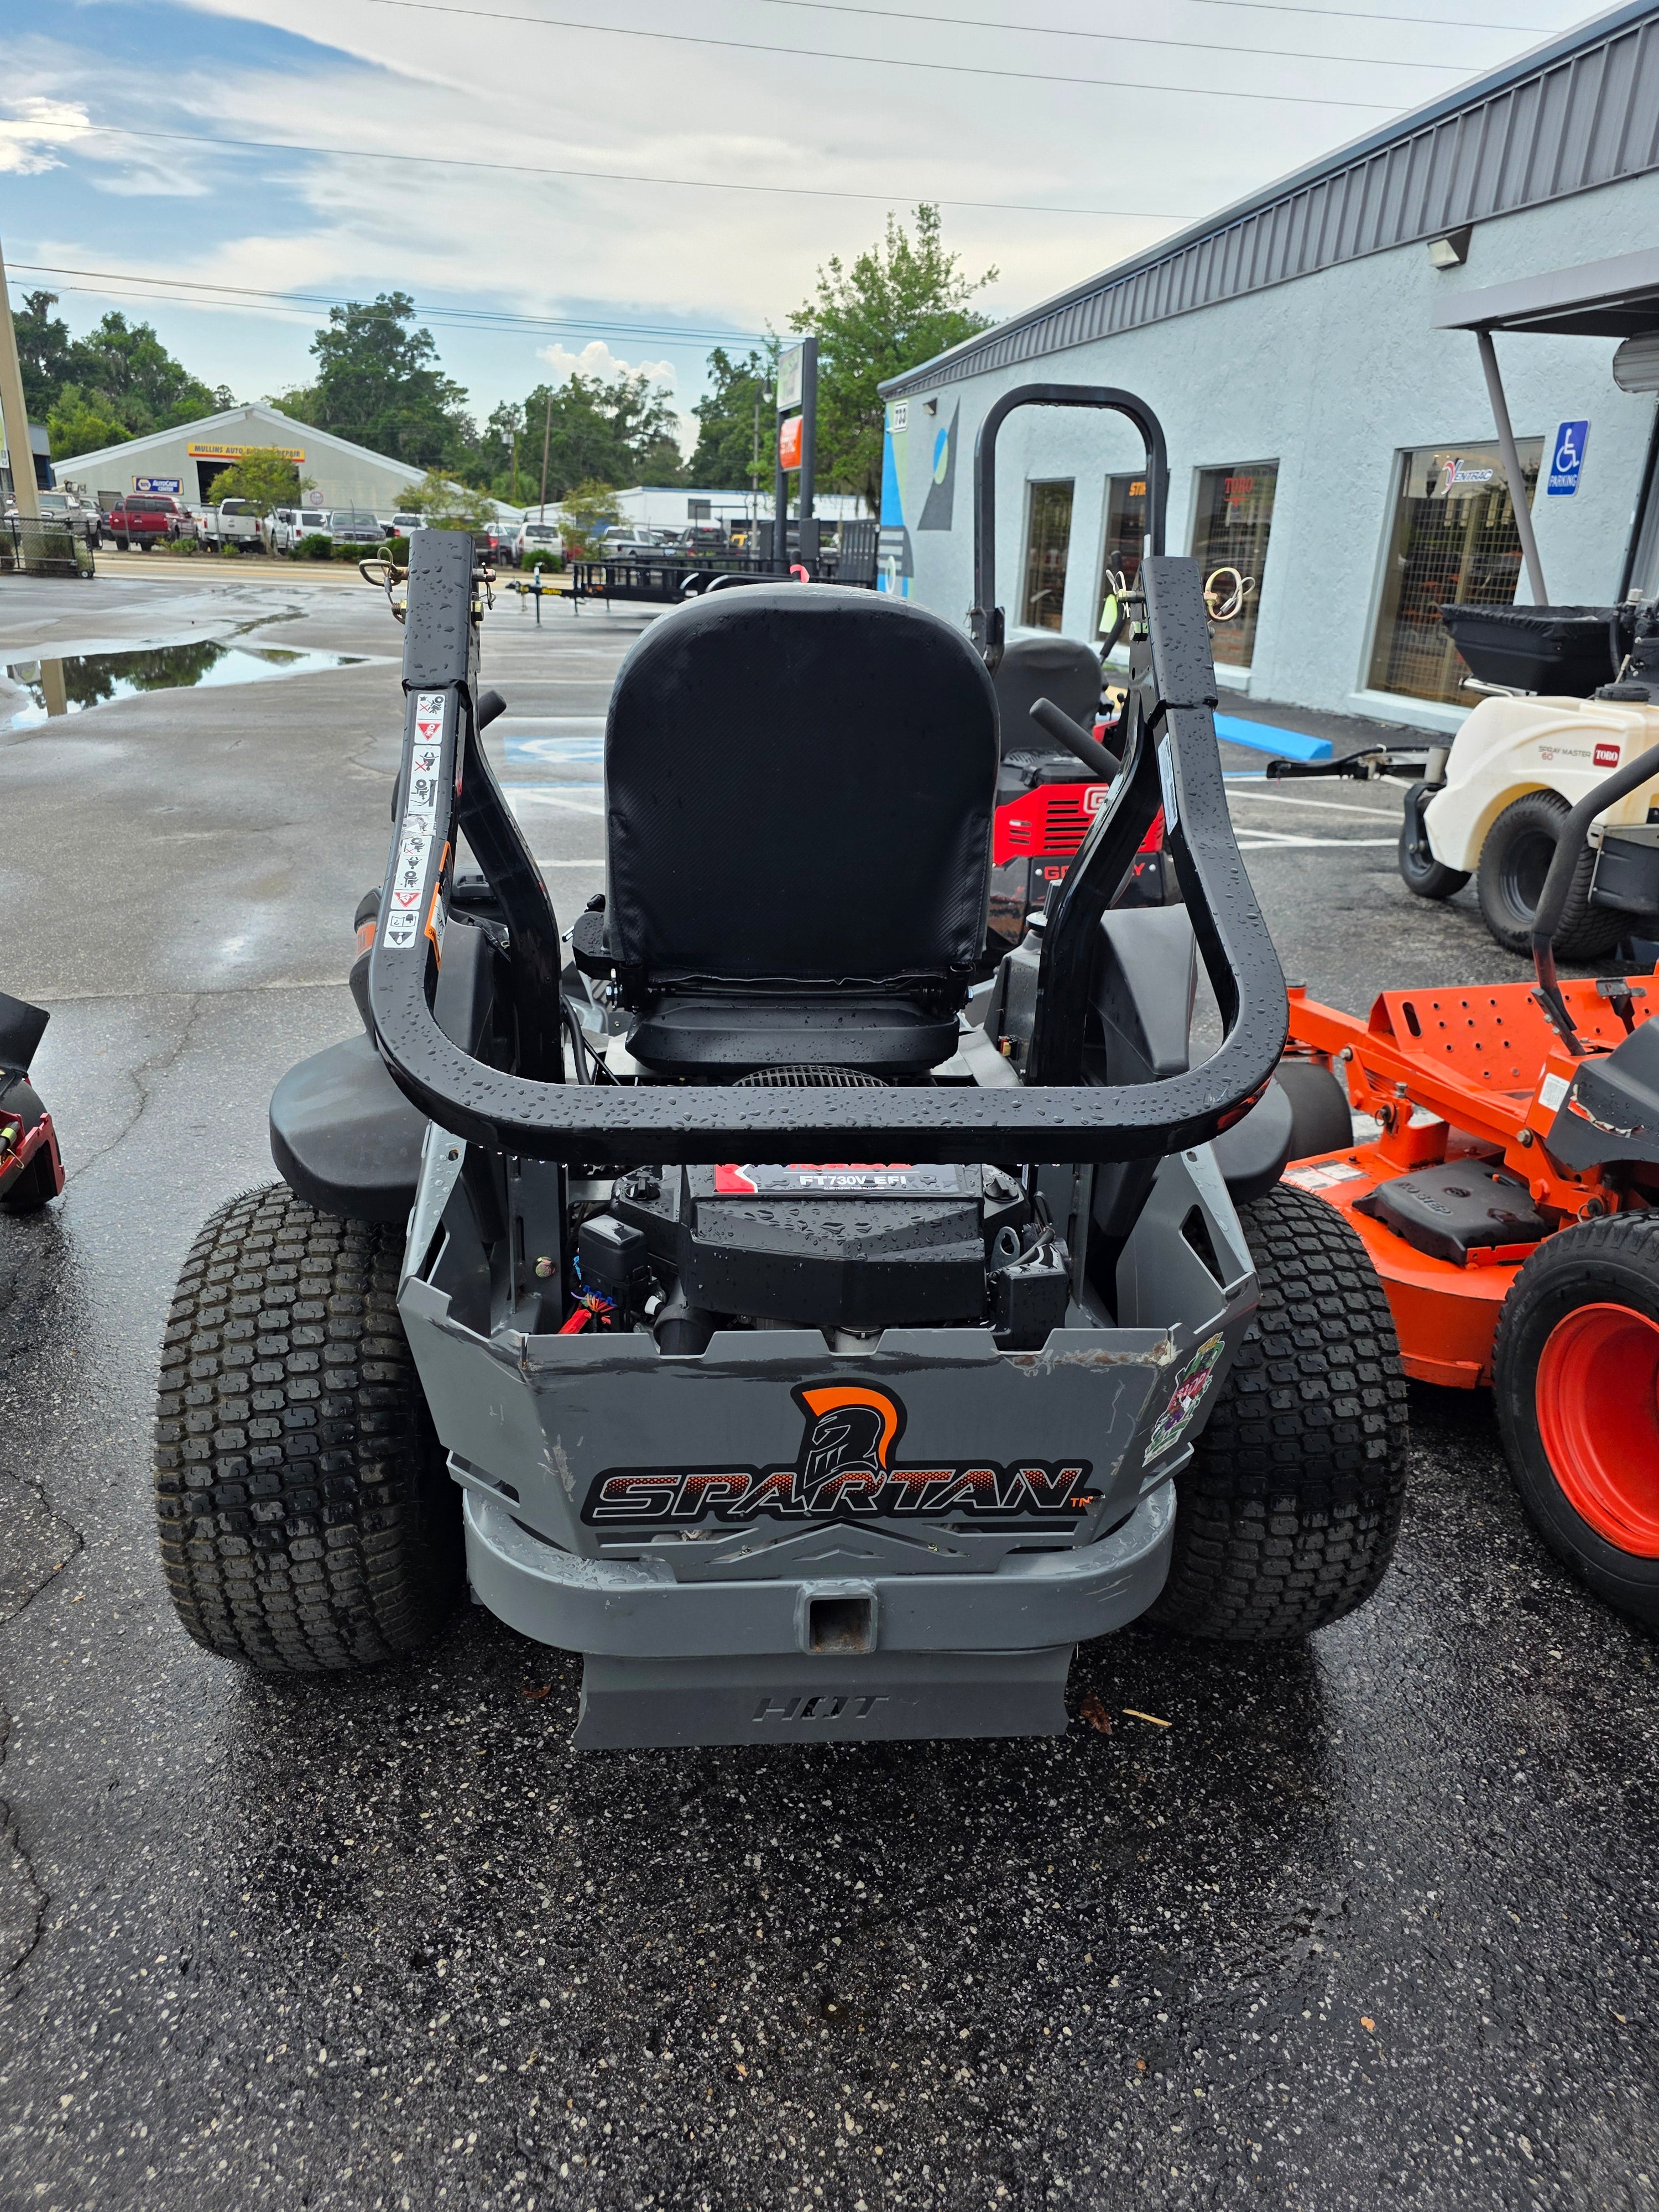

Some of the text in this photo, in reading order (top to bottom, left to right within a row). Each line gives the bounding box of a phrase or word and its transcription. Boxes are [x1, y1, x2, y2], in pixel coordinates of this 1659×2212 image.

[195, 445, 222, 453] MULLINS
[277, 449, 300, 457] REPAIR
[1441, 460, 1493, 494] VENTRAC
[1548, 474, 1578, 487] PARKING
[1224, 477, 1254, 494] TORO
[1542, 752, 1554, 760] 60
[1562, 748, 1591, 758] MASTER
[1595, 749, 1618, 761] TORO
[800, 1175, 907, 1186] FT730V EFI
[1415, 1193, 1452, 1214] STEP
[593, 1467, 1083, 1519] SPARTAN
[752, 1695, 890, 1722] HOT
